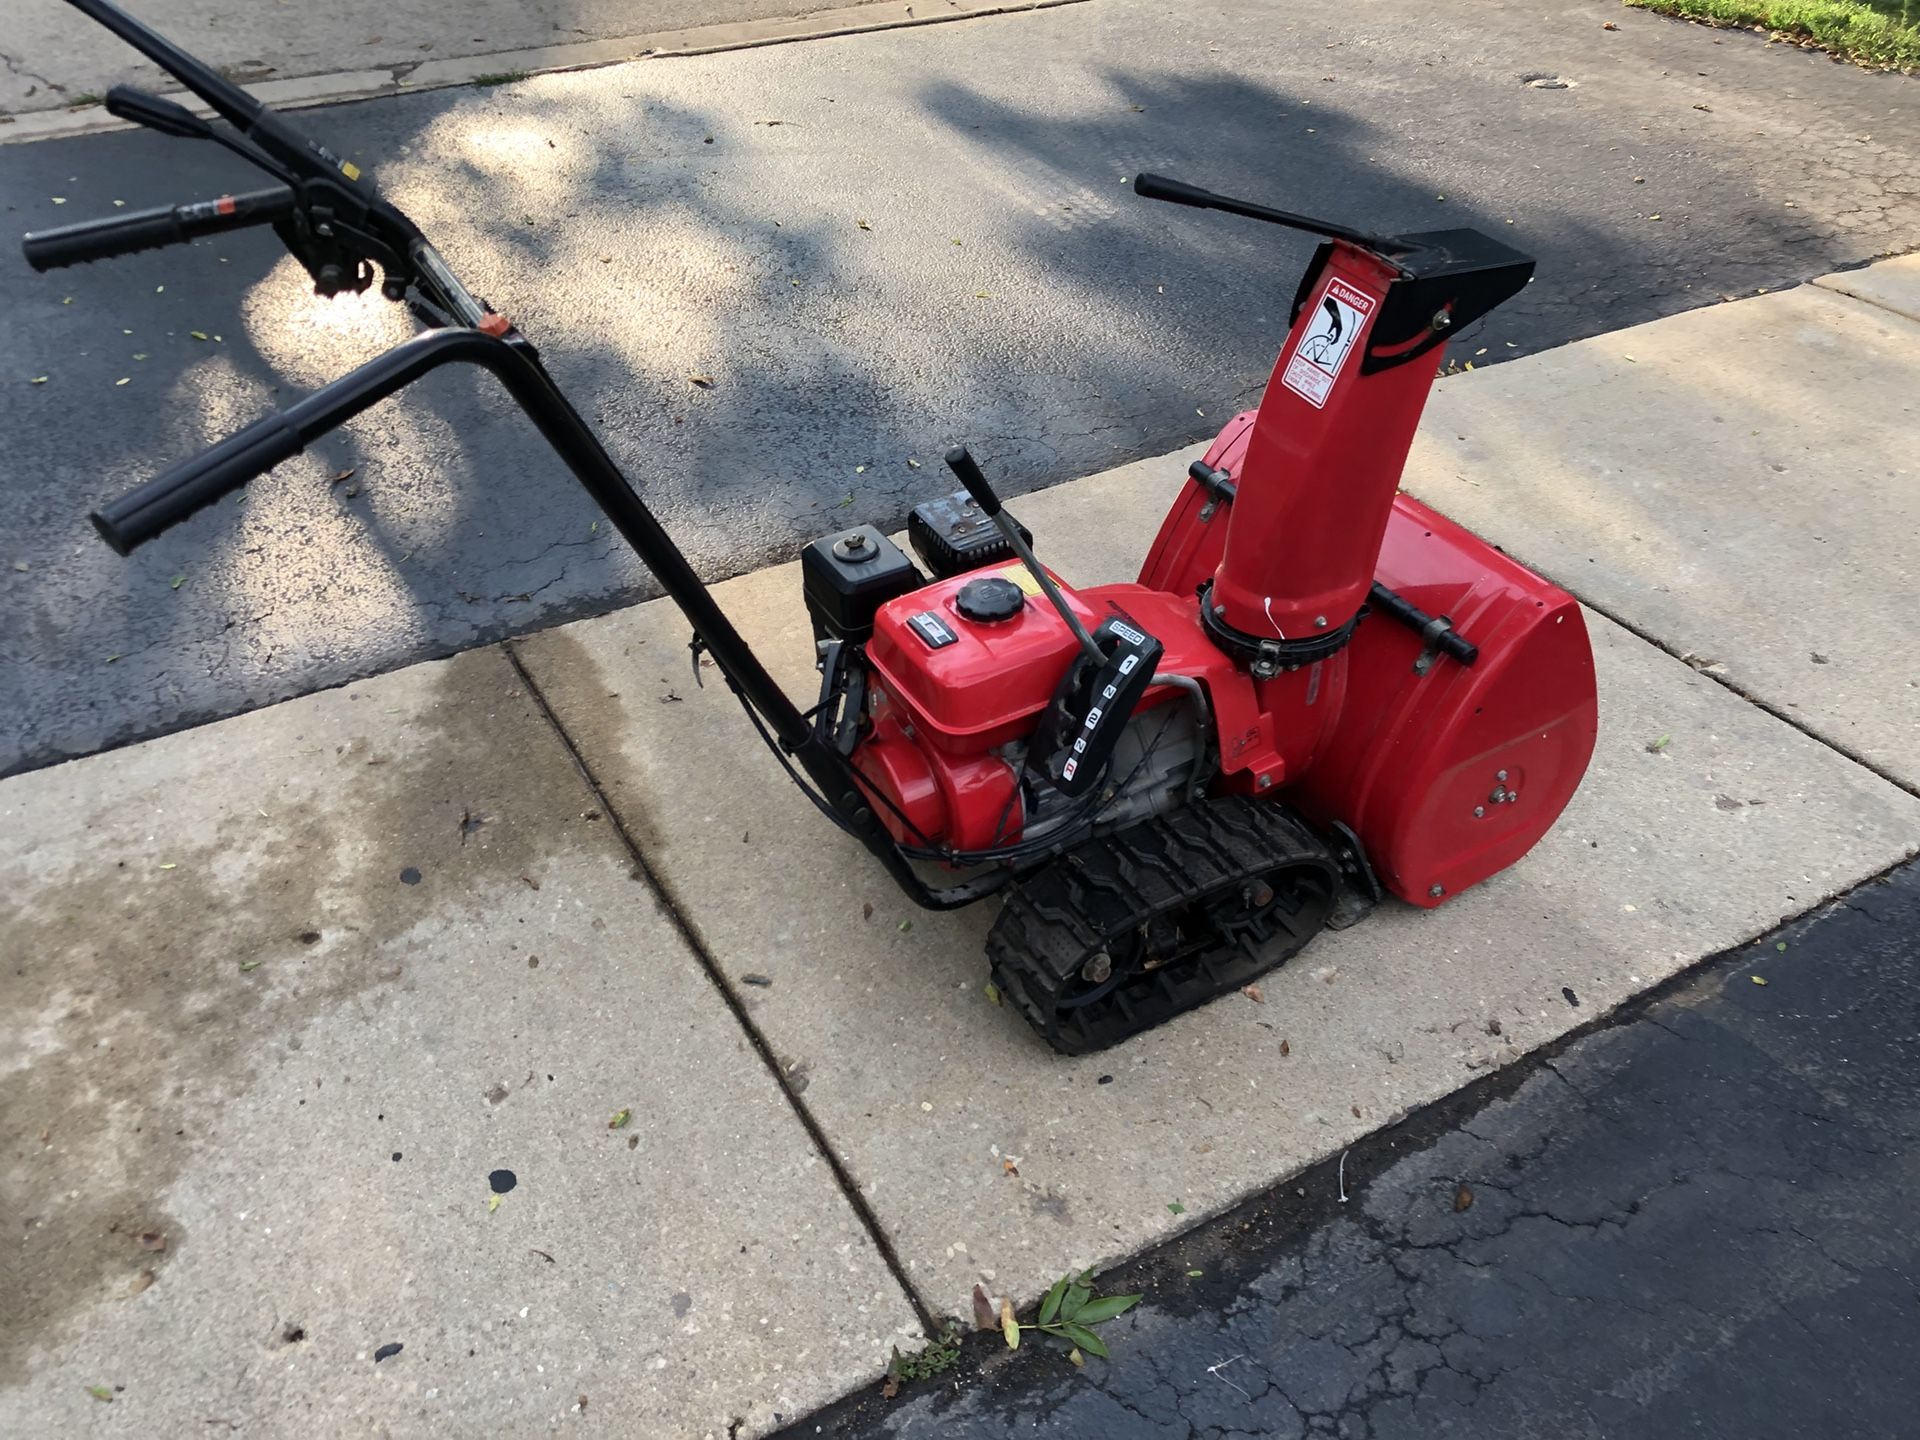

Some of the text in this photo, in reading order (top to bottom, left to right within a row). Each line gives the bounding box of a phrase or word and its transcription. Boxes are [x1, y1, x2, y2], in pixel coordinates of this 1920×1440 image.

[1339, 288, 1369, 311] DANGER
[1111, 622, 1143, 644] SPEED
[1126, 660, 1133, 670] 1
[1105, 686, 1114, 697] N
[1088, 712, 1098, 725] 2
[1075, 740, 1085, 750] N
